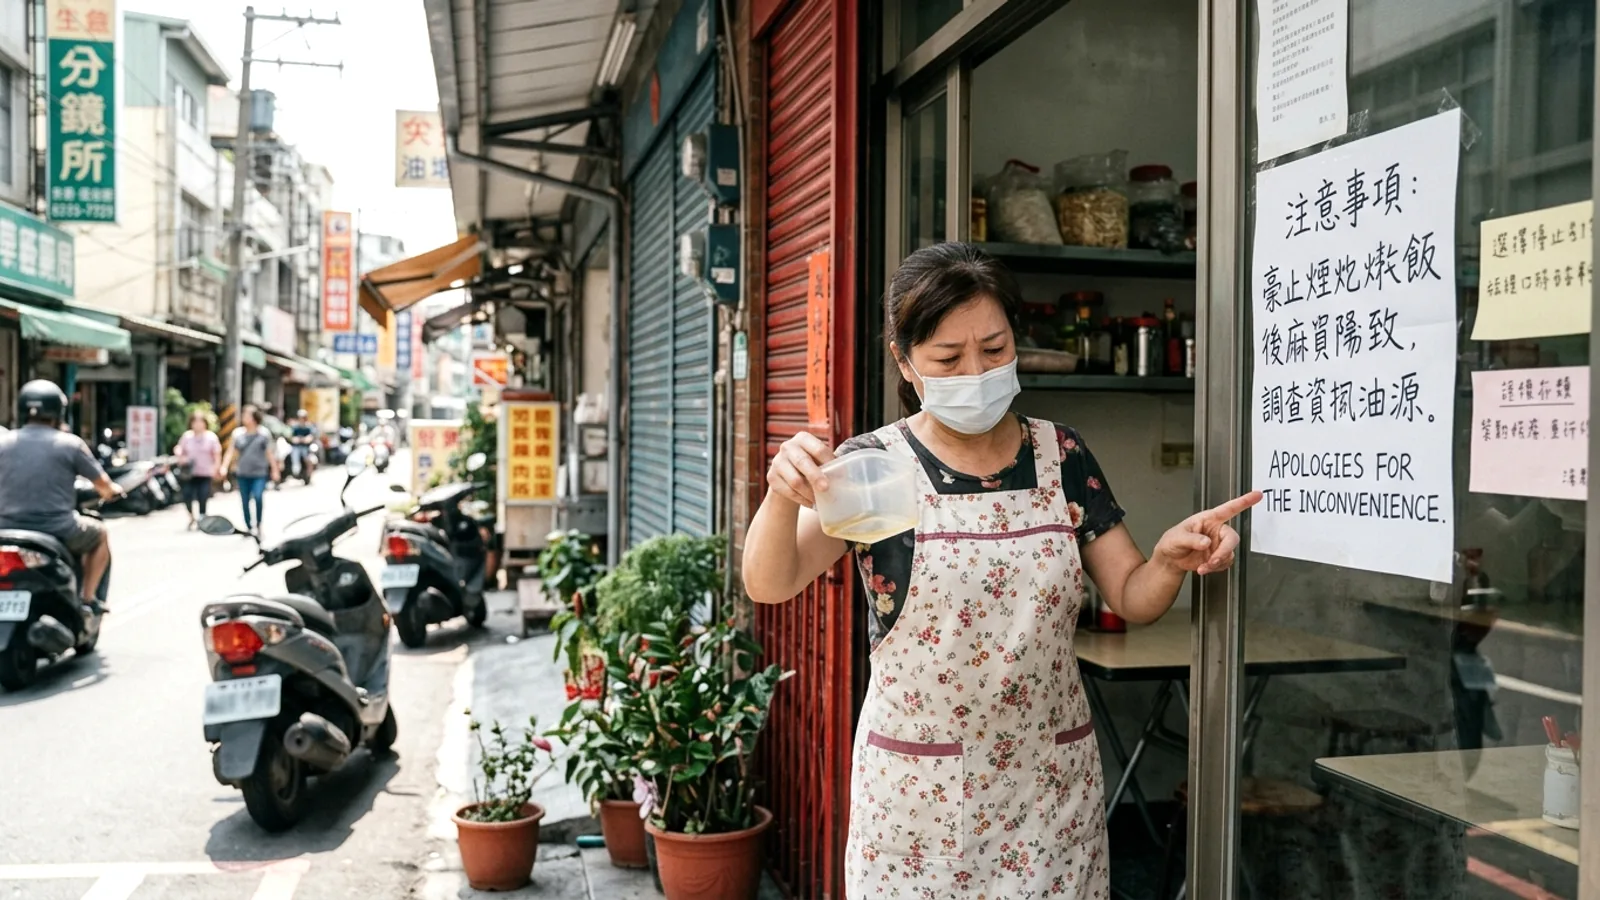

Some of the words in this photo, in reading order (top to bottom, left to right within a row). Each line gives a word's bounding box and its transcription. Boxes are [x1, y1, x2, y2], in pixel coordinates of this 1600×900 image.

[59, 45, 107, 183] 分鏡所
[1286, 163, 1416, 239] 注意事項：
[1269, 450, 1363, 478] APOLOGIES
[1377, 453, 1414, 480] FOR
[1263, 489, 1291, 512] THE
[1300, 490, 1445, 523] INCONVENIENCE.
